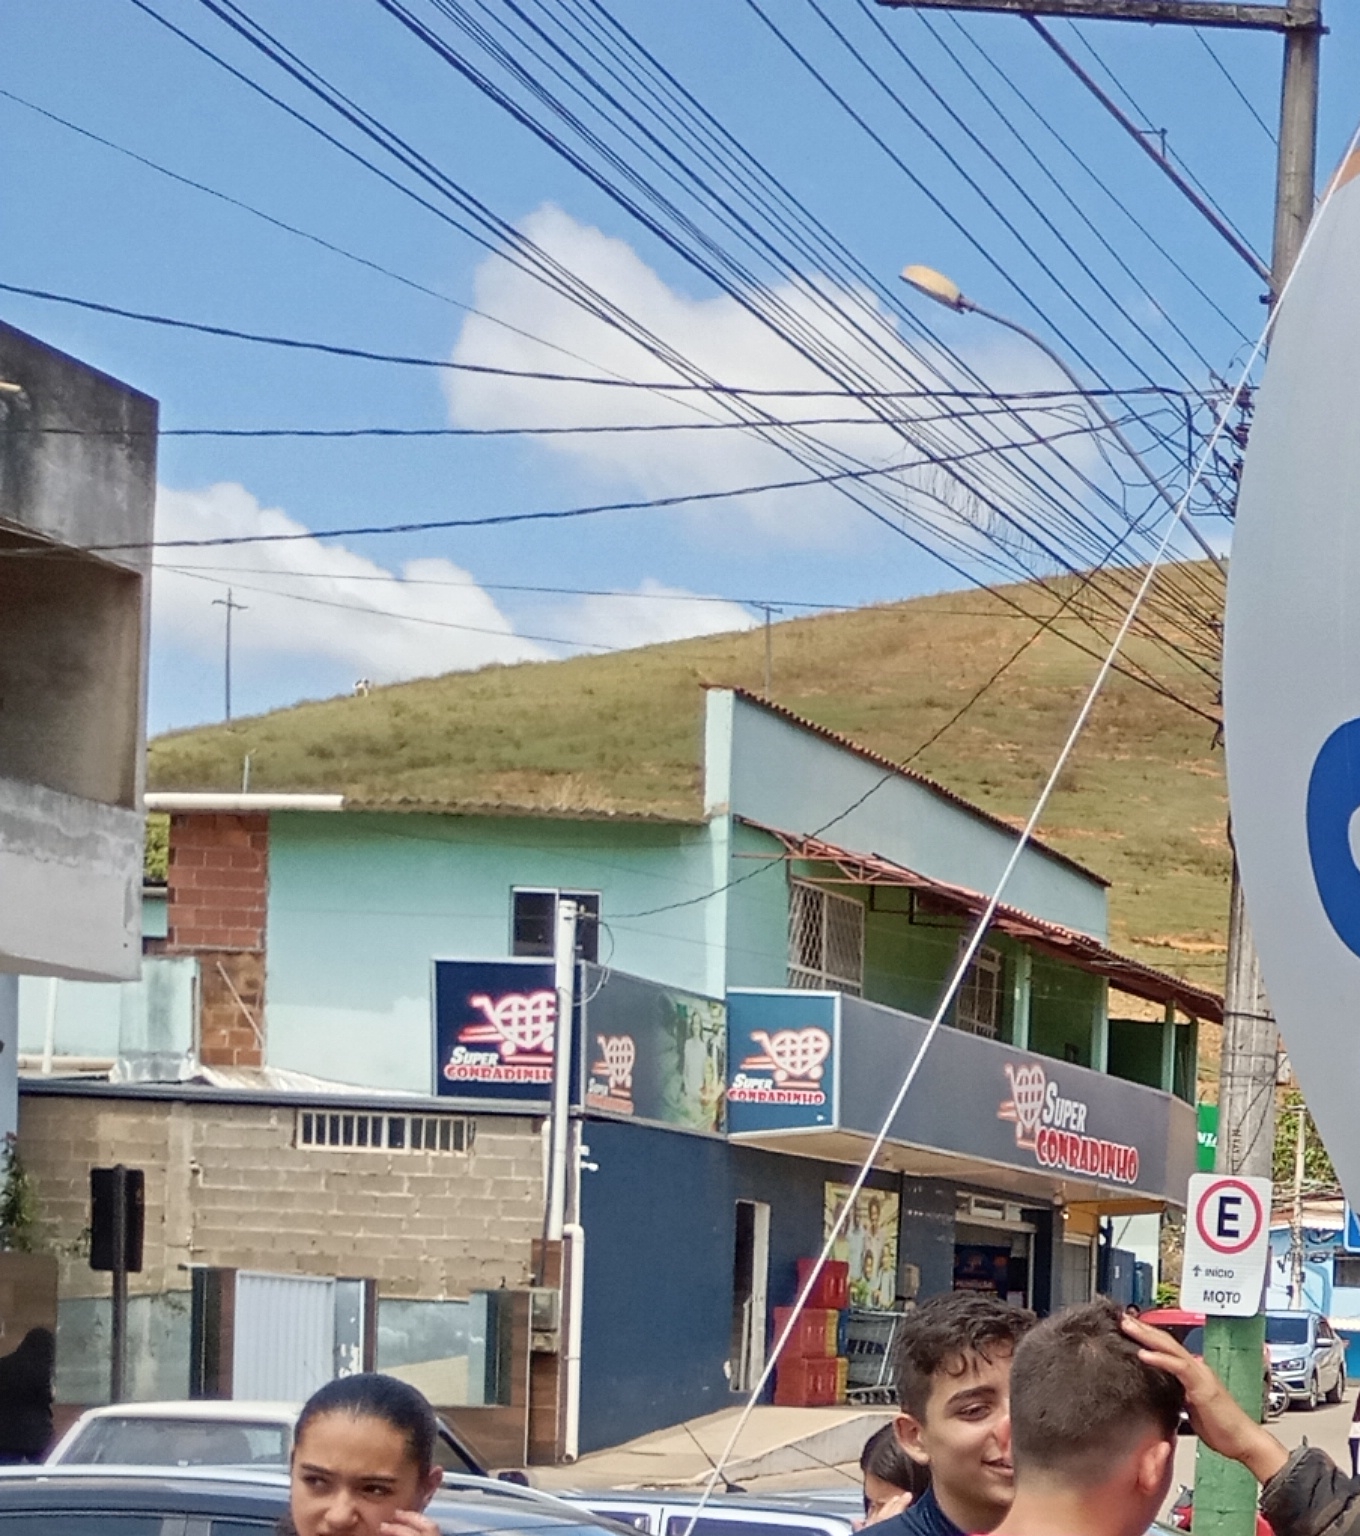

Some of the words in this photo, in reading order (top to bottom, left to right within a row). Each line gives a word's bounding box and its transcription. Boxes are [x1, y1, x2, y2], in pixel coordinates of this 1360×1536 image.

[444, 1065, 553, 1084] CONRADINH
[1034, 1125, 1140, 1184] CONRADINHO
[1217, 1196, 1242, 1238] E
[1203, 1290, 1241, 1304] MOTO
